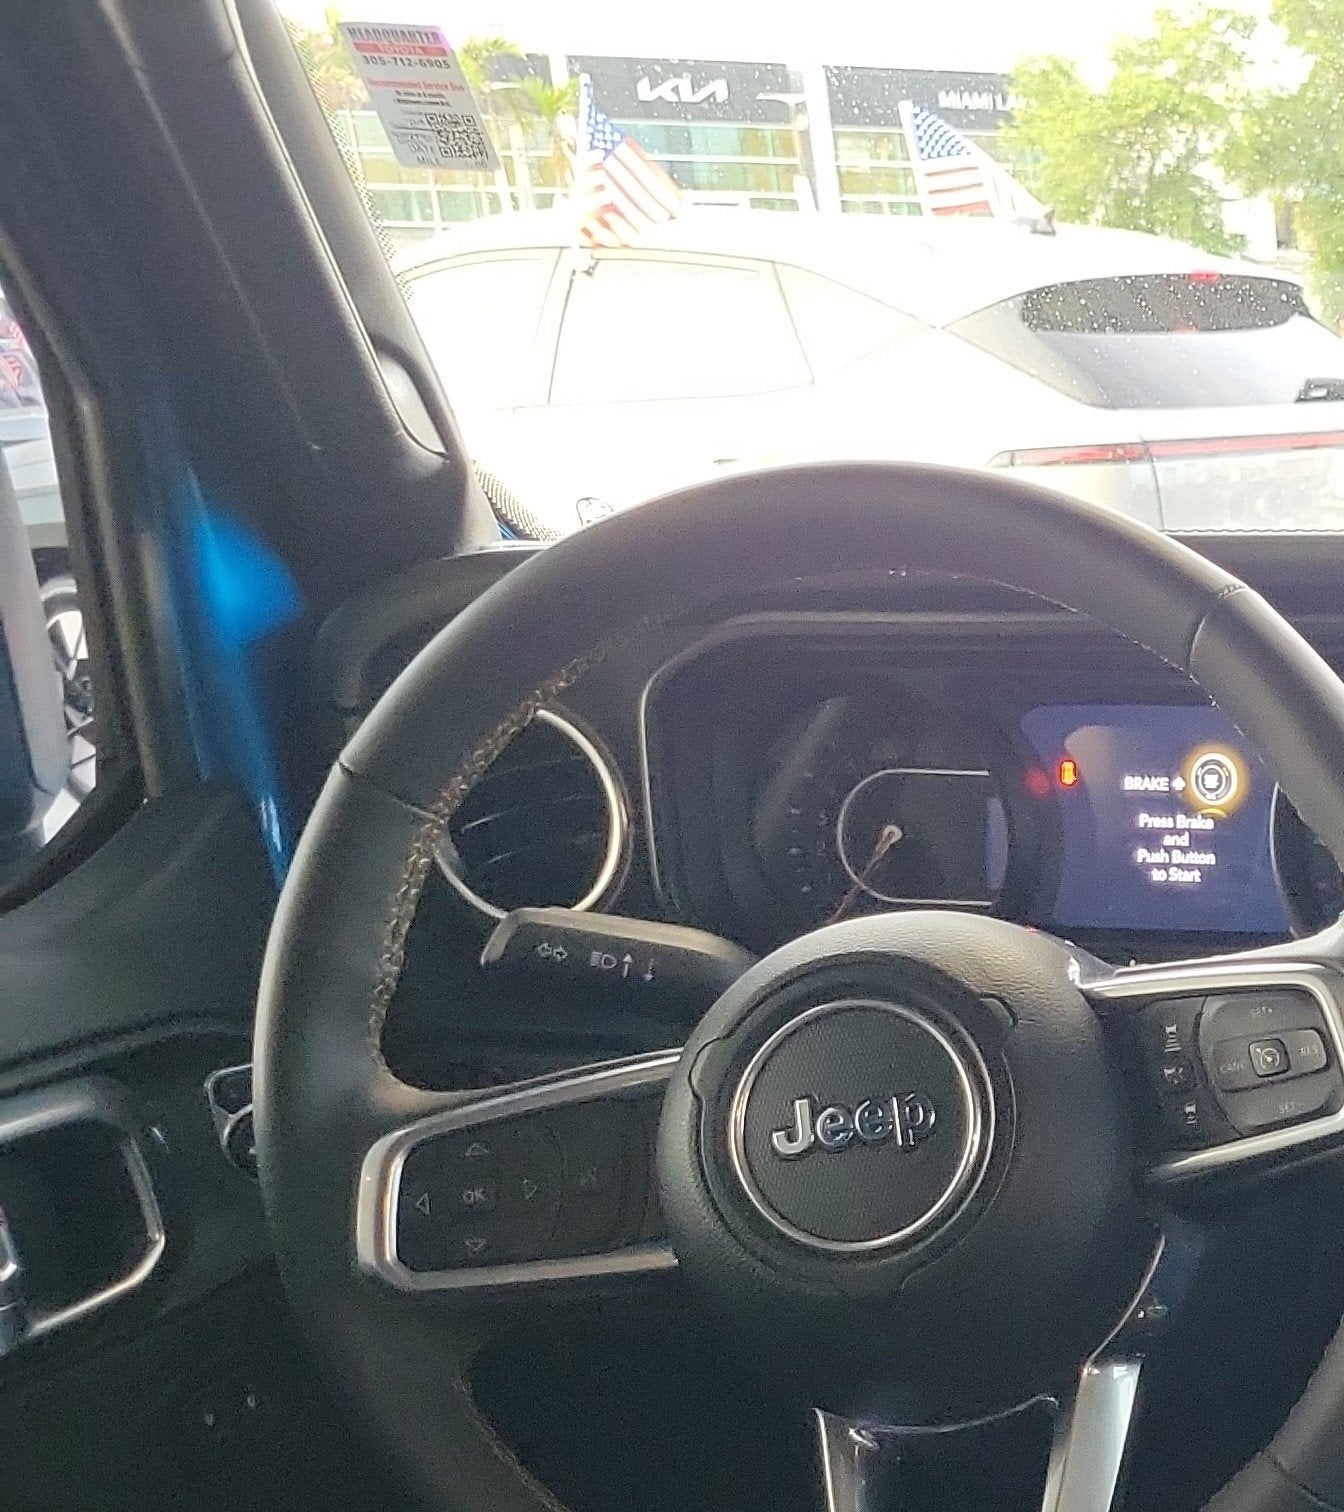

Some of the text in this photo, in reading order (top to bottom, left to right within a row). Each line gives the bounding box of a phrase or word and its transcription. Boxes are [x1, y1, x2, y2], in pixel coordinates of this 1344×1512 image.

[1124, 776, 1170, 792] BRAKE
[1138, 812, 1215, 830] Press Brake
[1162, 831, 1190, 847] and
[1137, 848, 1216, 866] Push Button
[1150, 867, 1202, 883] to Start
[771, 1092, 937, 1155] Jeep
